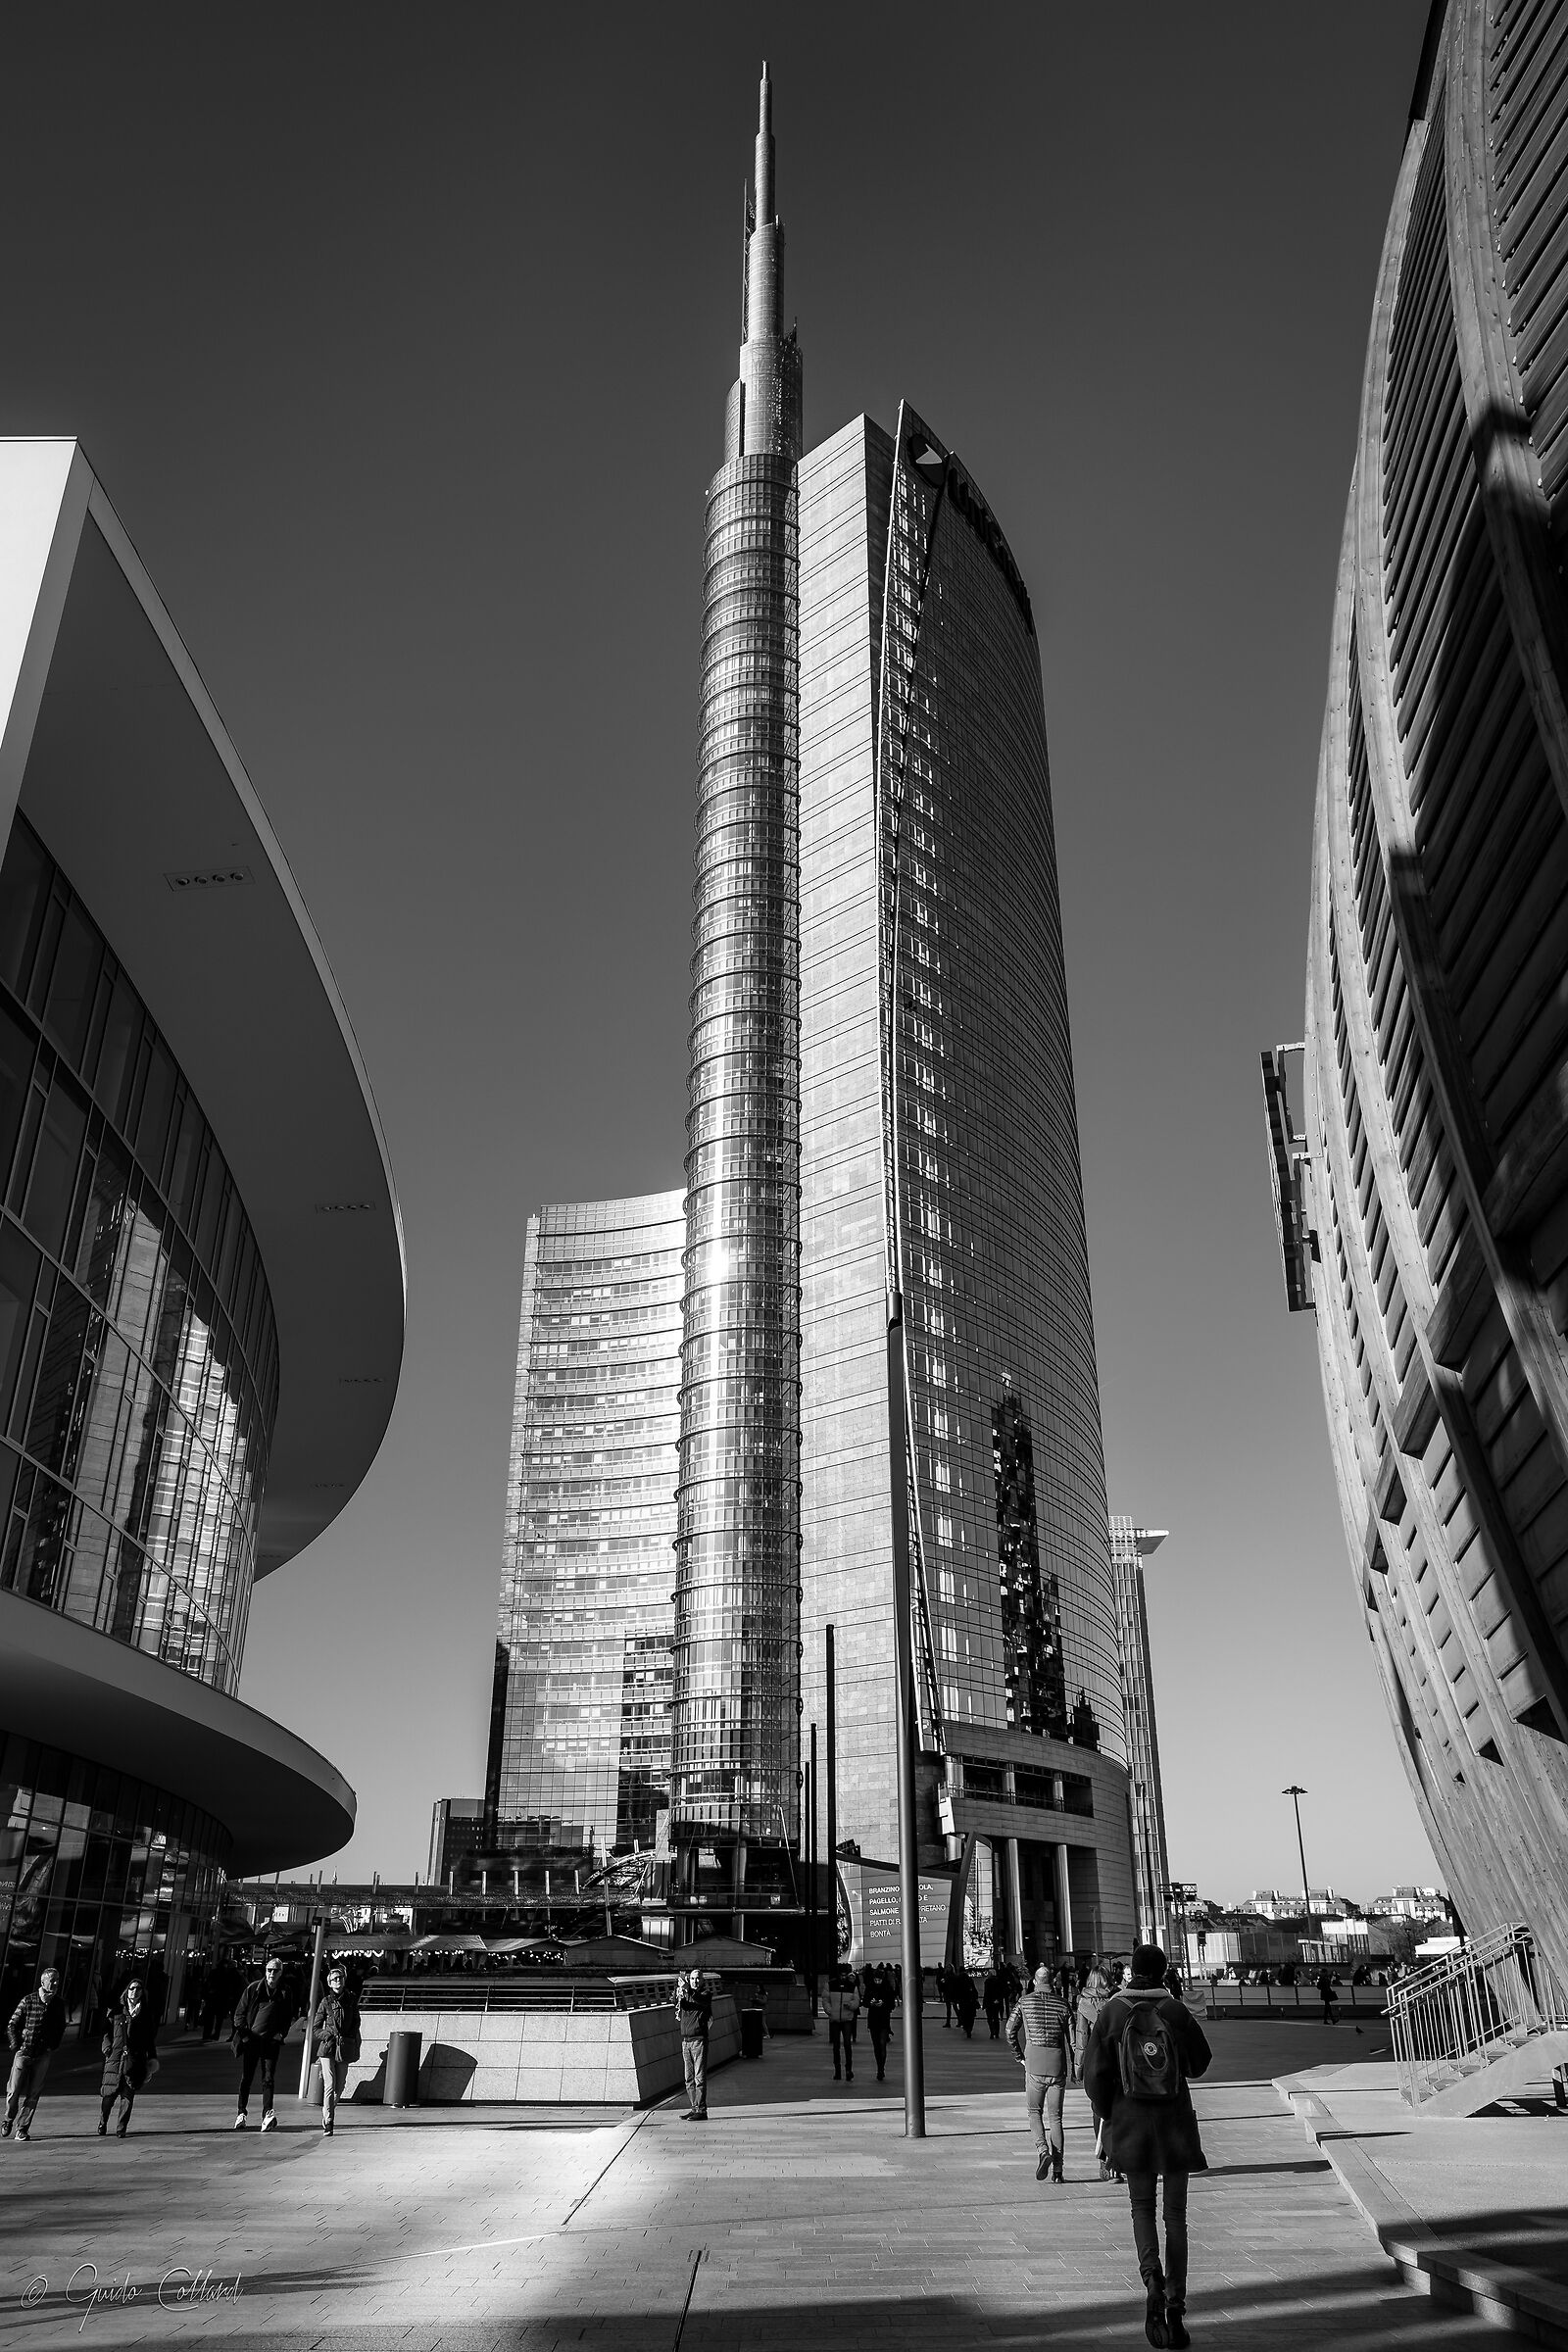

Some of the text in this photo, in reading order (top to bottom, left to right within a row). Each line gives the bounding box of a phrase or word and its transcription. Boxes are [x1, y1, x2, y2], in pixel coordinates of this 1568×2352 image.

[868, 1886, 900, 1894] BRANZINO
[869, 1896, 899, 1905] PAGELLO,
[869, 1907, 900, 1916] SALMONE
